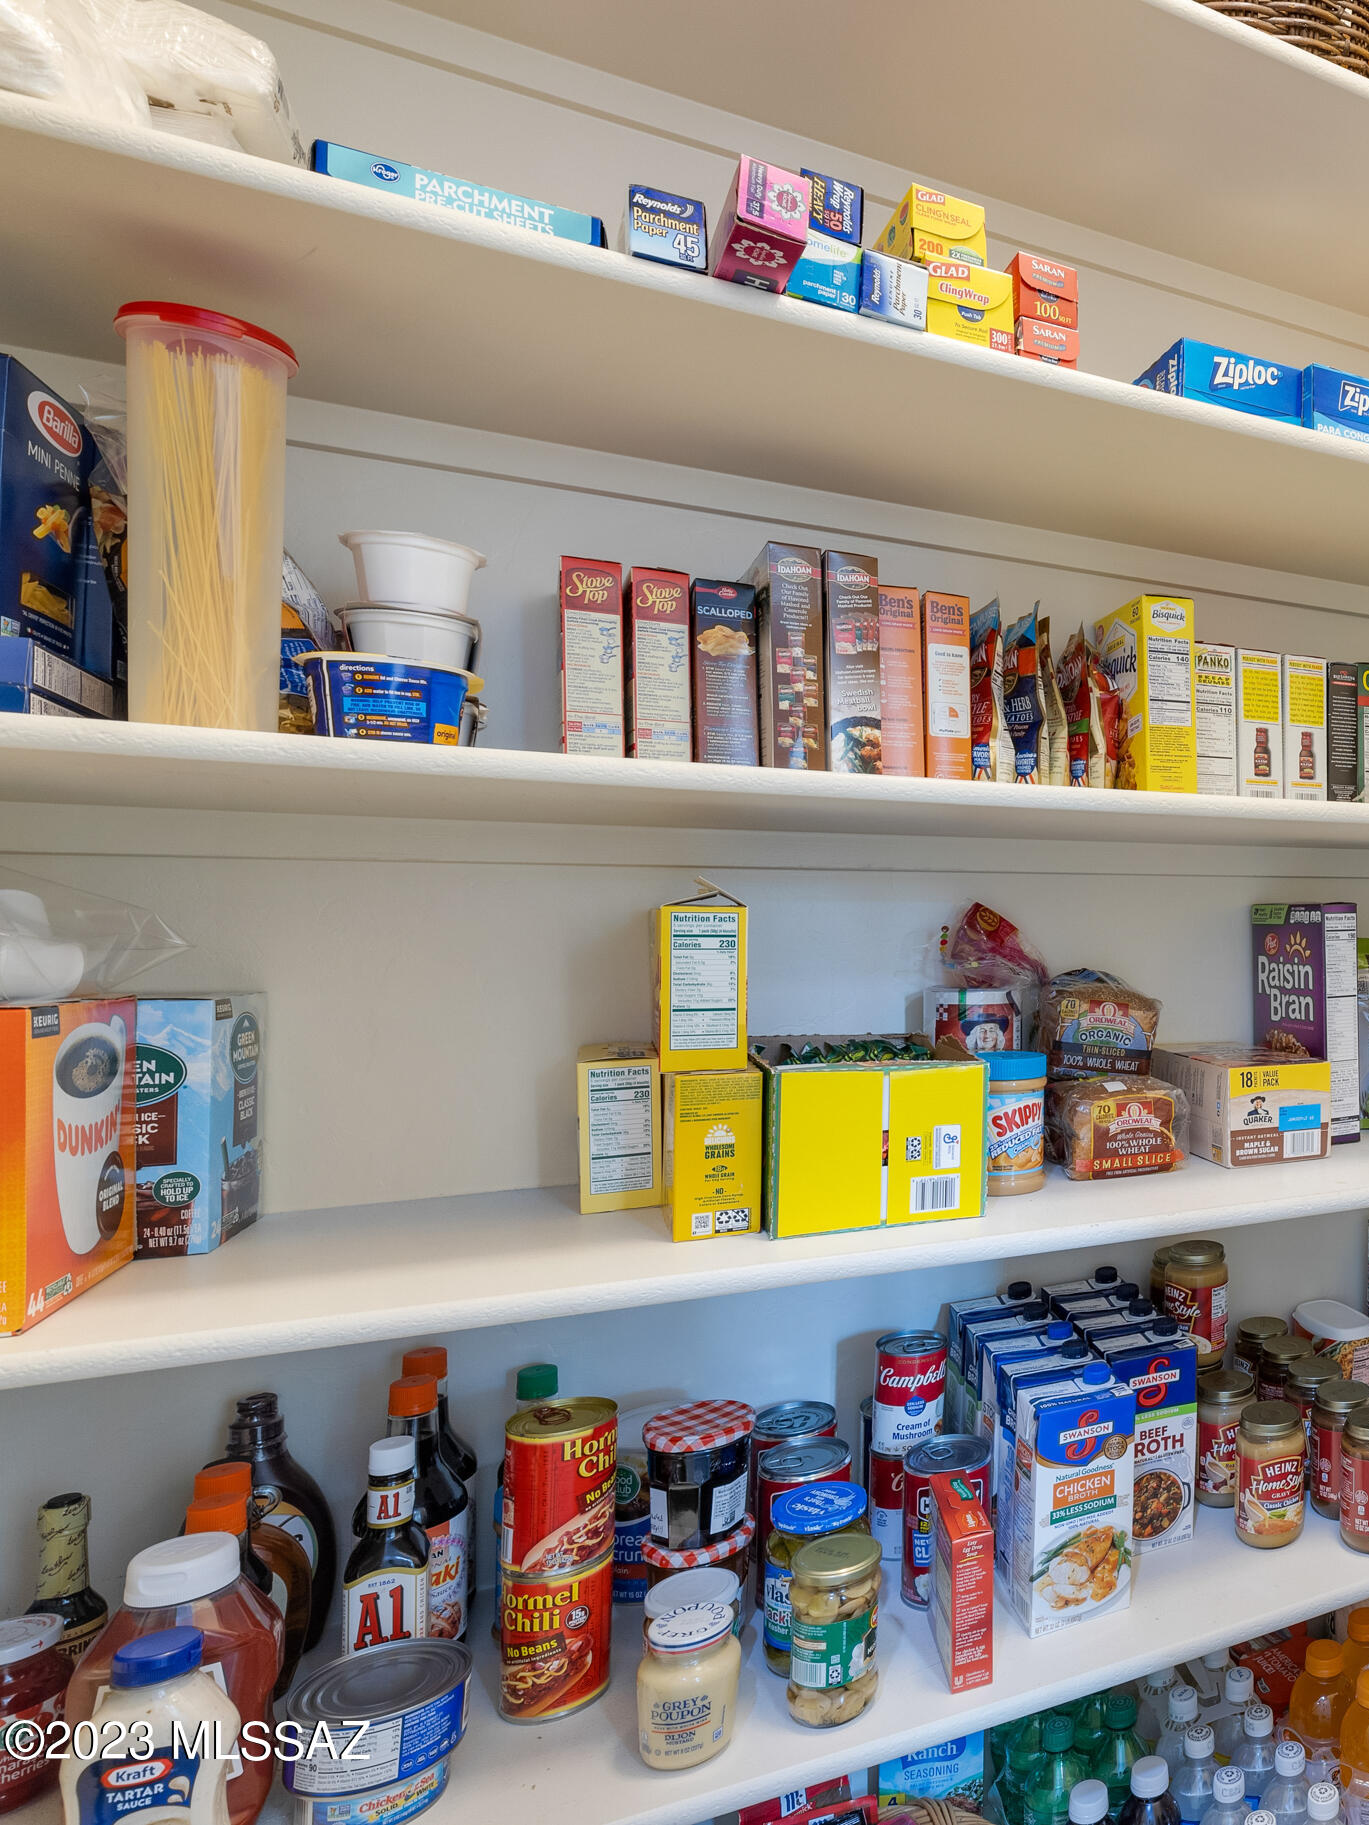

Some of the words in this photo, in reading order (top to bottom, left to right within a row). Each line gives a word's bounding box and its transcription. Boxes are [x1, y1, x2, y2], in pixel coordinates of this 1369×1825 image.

[372, 165, 399, 180] Kroger
[414, 172, 554, 224] PARCHMENT
[812, 176, 826, 224] HEAVY
[831, 181, 843, 208] Wrap
[918, 191, 944, 203] GLAD
[632, 193, 682, 215] Reynolds
[842, 186, 854, 234] Reynolds
[493, 211, 555, 237] SHEETS
[633, 207, 699, 236] Parchment
[633, 219, 669, 238] Paper
[829, 212, 843, 233] 50
[672, 232, 700, 258] 45
[919, 238, 943, 255] 200
[929, 263, 968, 278] GLAD
[1031, 260, 1065, 278] SARAN
[803, 279, 836, 294] parchment
[872, 269, 881, 303] Reynolds
[818, 290, 836, 299] paper
[841, 293, 856, 305] 30
[939, 282, 989, 306] ClingWrap
[1034, 301, 1059, 319] 100
[992, 331, 1008, 345] 300
[1033, 325, 1066, 341] SARAN
[1213, 355, 1279, 386] Ziploc
[41, 404, 80, 448] Barilla
[1317, 422, 1342, 439] PARA
[27, 441, 52, 466] MINI
[54, 459, 80, 492] PENNE
[777, 565, 812, 575] IDAHOAN
[566, 572, 614, 597] Stove
[837, 574, 869, 584] IDAHOAN
[584, 589, 608, 604] Top
[637, 583, 681, 607] Stove
[879, 594, 914, 610] Ben's
[654, 599, 676, 614] Top
[697, 605, 753, 620] SCALLOPED
[879, 608, 914, 619] Original
[930, 600, 964, 617] Ben's
[930, 614, 964, 625] Original
[1152, 609, 1185, 622] Bisquick
[339, 664, 375, 672] directions
[1197, 654, 1229, 669] PANKO
[1012, 696, 1031, 711] HERB
[673, 914, 710, 922] Nutrition
[713, 915, 736, 923] Facts
[719, 940, 736, 948] 230
[1257, 955, 1314, 995] Raisin
[1270, 988, 1314, 1022] Bran
[33, 1014, 59, 1028] KEURIG
[1088, 1016, 1127, 1026] OROWEAT
[1079, 1029, 1132, 1046] ORGANIC
[1082, 1044, 1126, 1057] THIN-SLICED
[1064, 1054, 1084, 1066] 100%
[1087, 1056, 1112, 1068] WHOLE
[1115, 1059, 1140, 1072] WHEAT
[590, 1068, 625, 1078] Nutrition
[629, 1067, 649, 1077] Facts
[1240, 1071, 1253, 1089] 18
[1262, 1070, 1279, 1078] VALUE
[1263, 1078, 1279, 1087] PACK
[591, 1092, 618, 1101] Calories
[633, 1090, 650, 1099] 230
[1096, 1104, 1111, 1114] 70
[991, 1101, 1042, 1138] SKIPPY
[1116, 1117, 1153, 1127] OROWEAT
[1243, 1115, 1273, 1126] QUAKER
[57, 1104, 120, 1156] DUNKIN'
[1106, 1140, 1129, 1150] 100%
[1130, 1137, 1162, 1146] WHOLE
[1118, 1146, 1150, 1156] WHEAT
[1236, 1147, 1254, 1155] BROWN
[1256, 1145, 1279, 1154] SUGAR
[1244, 1141, 1265, 1149] MAPLE
[704, 1150, 735, 1160] GRAINS
[1094, 1156, 1135, 1170] SMALL
[1136, 1153, 1172, 1166] SLICE
[163, 1176, 192, 1185] SPECIALLY
[99, 1180, 123, 1202] ORIGINAL
[160, 1188, 178, 1197] HOLD
[180, 1187, 193, 1195] UP
[176, 1193, 189, 1202] ICE
[102, 1195, 120, 1212] BLEND
[27, 1289, 45, 1317] 44
[1131, 1369, 1180, 1388] SWANSON
[896, 1422, 919, 1432] Cream
[922, 1420, 931, 1428] of
[1063, 1424, 1110, 1441] SWANSON
[1140, 1426, 1168, 1440] BEEF
[892, 1428, 933, 1441] Mushroom
[1055, 1468, 1081, 1482] Natural
[1082, 1464, 1114, 1475] Goodness
[1266, 1461, 1299, 1478] HEINZ
[1056, 1475, 1111, 1497] CHICKEN
[586, 1489, 600, 1504] No
[1068, 1489, 1098, 1502] BROTH
[1271, 1490, 1291, 1499] GRAVY
[1052, 1509, 1066, 1519] 33%
[1066, 1504, 1084, 1515] LESS
[1085, 1498, 1114, 1511] SODIUM
[1264, 1500, 1282, 1509] Classic
[504, 1609, 560, 1632] Chili
[768, 1625, 789, 1634] Kosher
[507, 1647, 519, 1657] No
[521, 1640, 557, 1656] Beans
[651, 1702, 712, 1721] POUPON
[662, 1697, 699, 1711] GREY
[665, 1730, 696, 1741] DIJON
[907, 1741, 957, 1763] Ranch
[115, 1764, 157, 1783] Kraft
[903, 1763, 959, 1781] SEASONING
[106, 1782, 164, 1804] TARTAR
[116, 1798, 152, 1812] SAUCE
